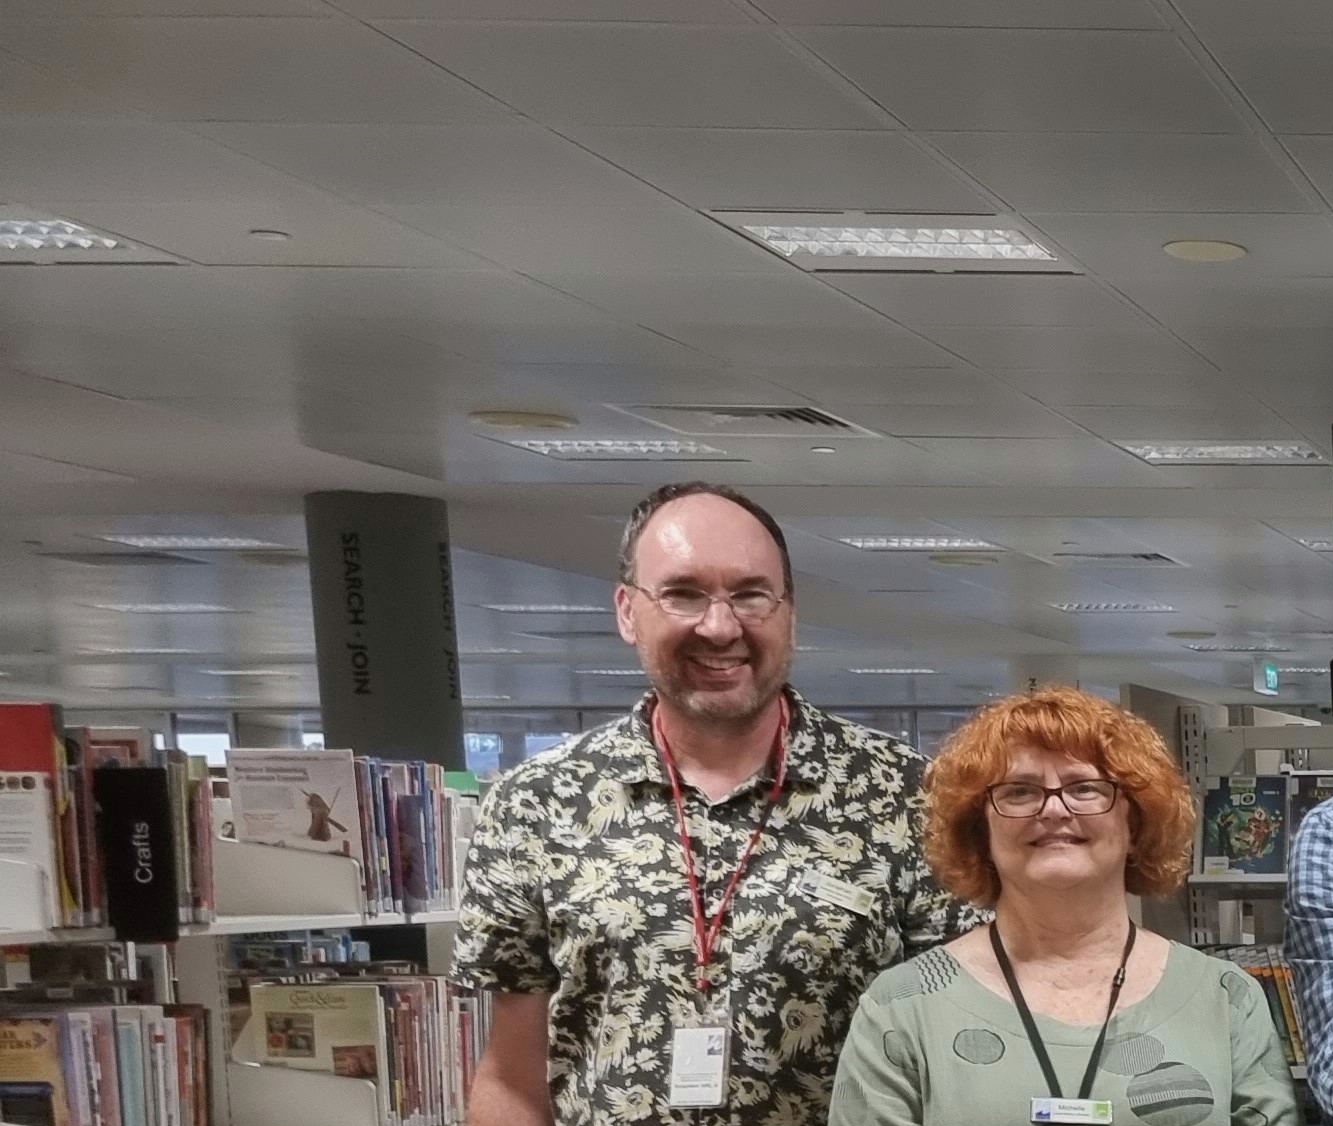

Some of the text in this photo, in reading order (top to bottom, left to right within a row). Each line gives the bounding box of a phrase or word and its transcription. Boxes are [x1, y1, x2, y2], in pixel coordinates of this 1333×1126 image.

[340, 532, 372, 695] SEARCH JOIN
[132, 821, 153, 883] Crafts
